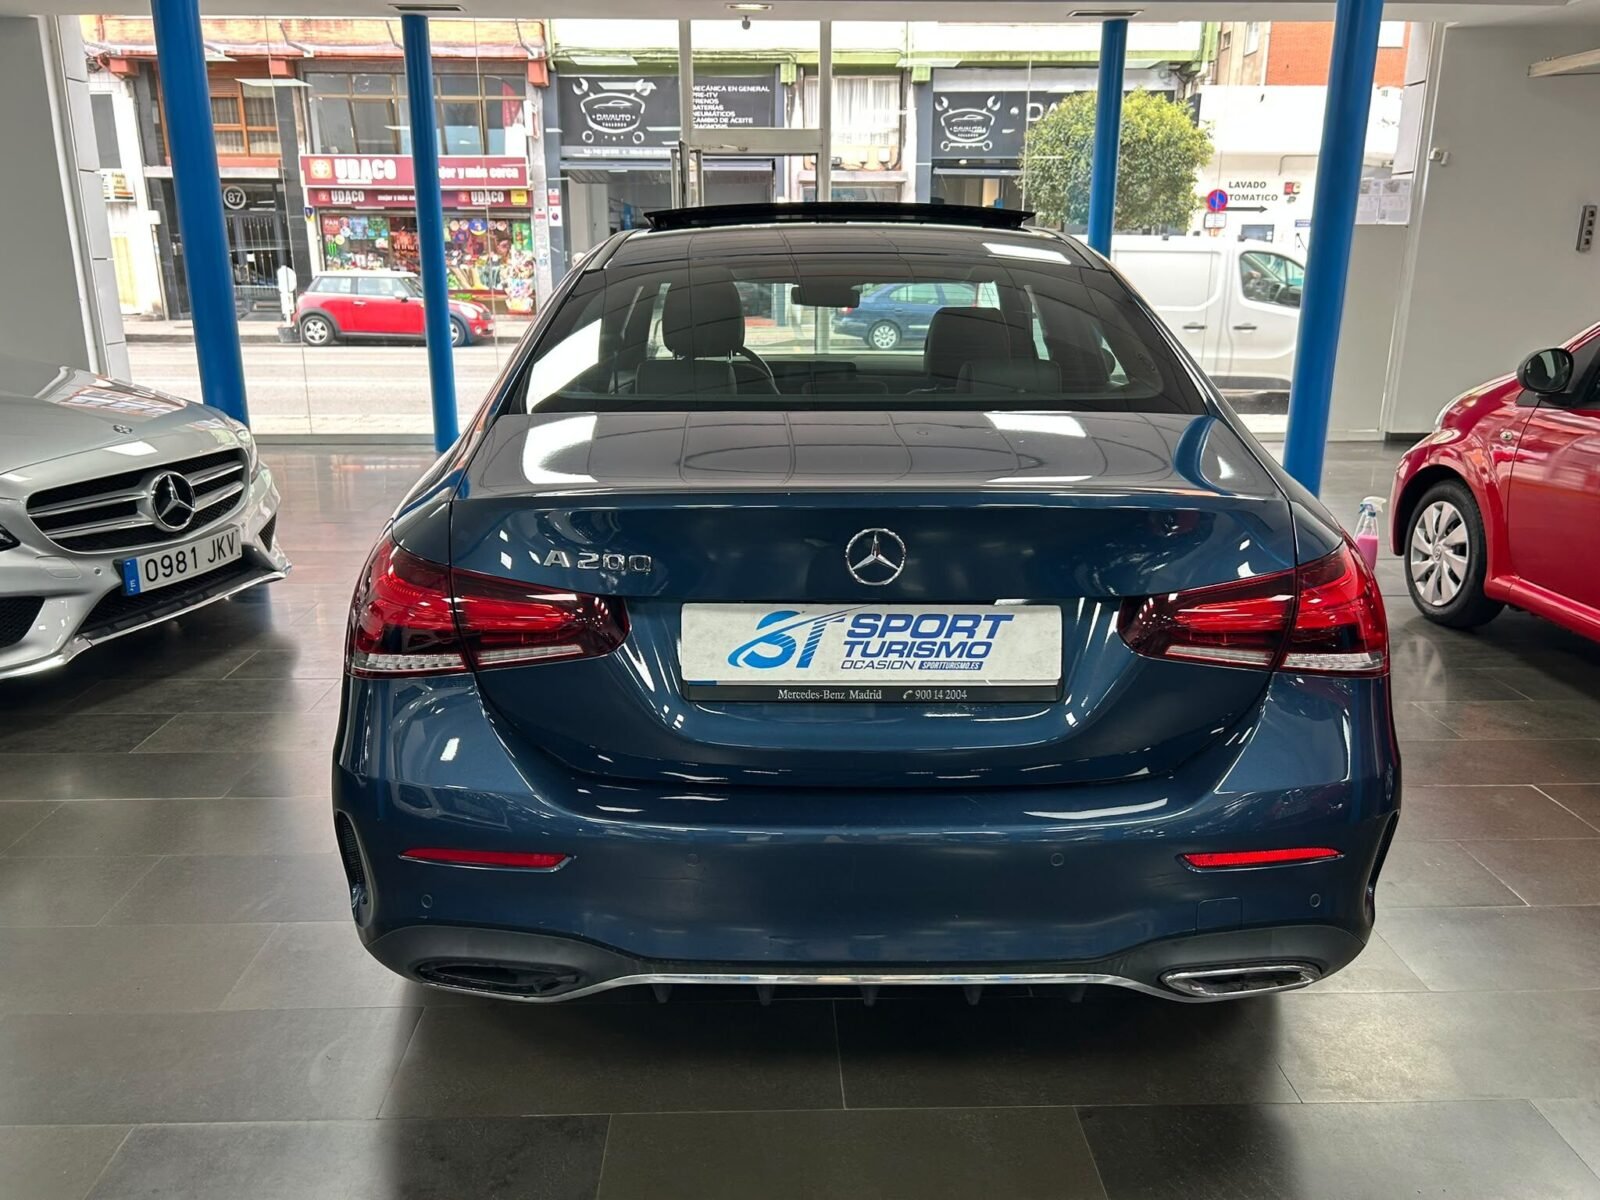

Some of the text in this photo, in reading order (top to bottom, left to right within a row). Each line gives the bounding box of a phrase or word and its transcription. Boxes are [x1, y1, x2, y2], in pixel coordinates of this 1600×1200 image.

[596, 113, 631, 121] DAVAUTO
[333, 158, 397, 180] UDACO
[489, 167, 519, 178] cerca
[1228, 181, 1267, 189] LAVADO
[228, 192, 241, 203] 87
[331, 190, 365, 202] UDACO
[471, 191, 504, 202] UDACO
[145, 532, 235, 582] 0981 JKV
[543, 550, 652, 572] A 200
[846, 613, 1014, 639] SPORT
[843, 640, 993, 659] TURISMO
[840, 659, 981, 670] OCASION SPORTTURISMO.ES
[778, 689, 967, 700] Mercedes-Benz Madrid 900 14 2004
